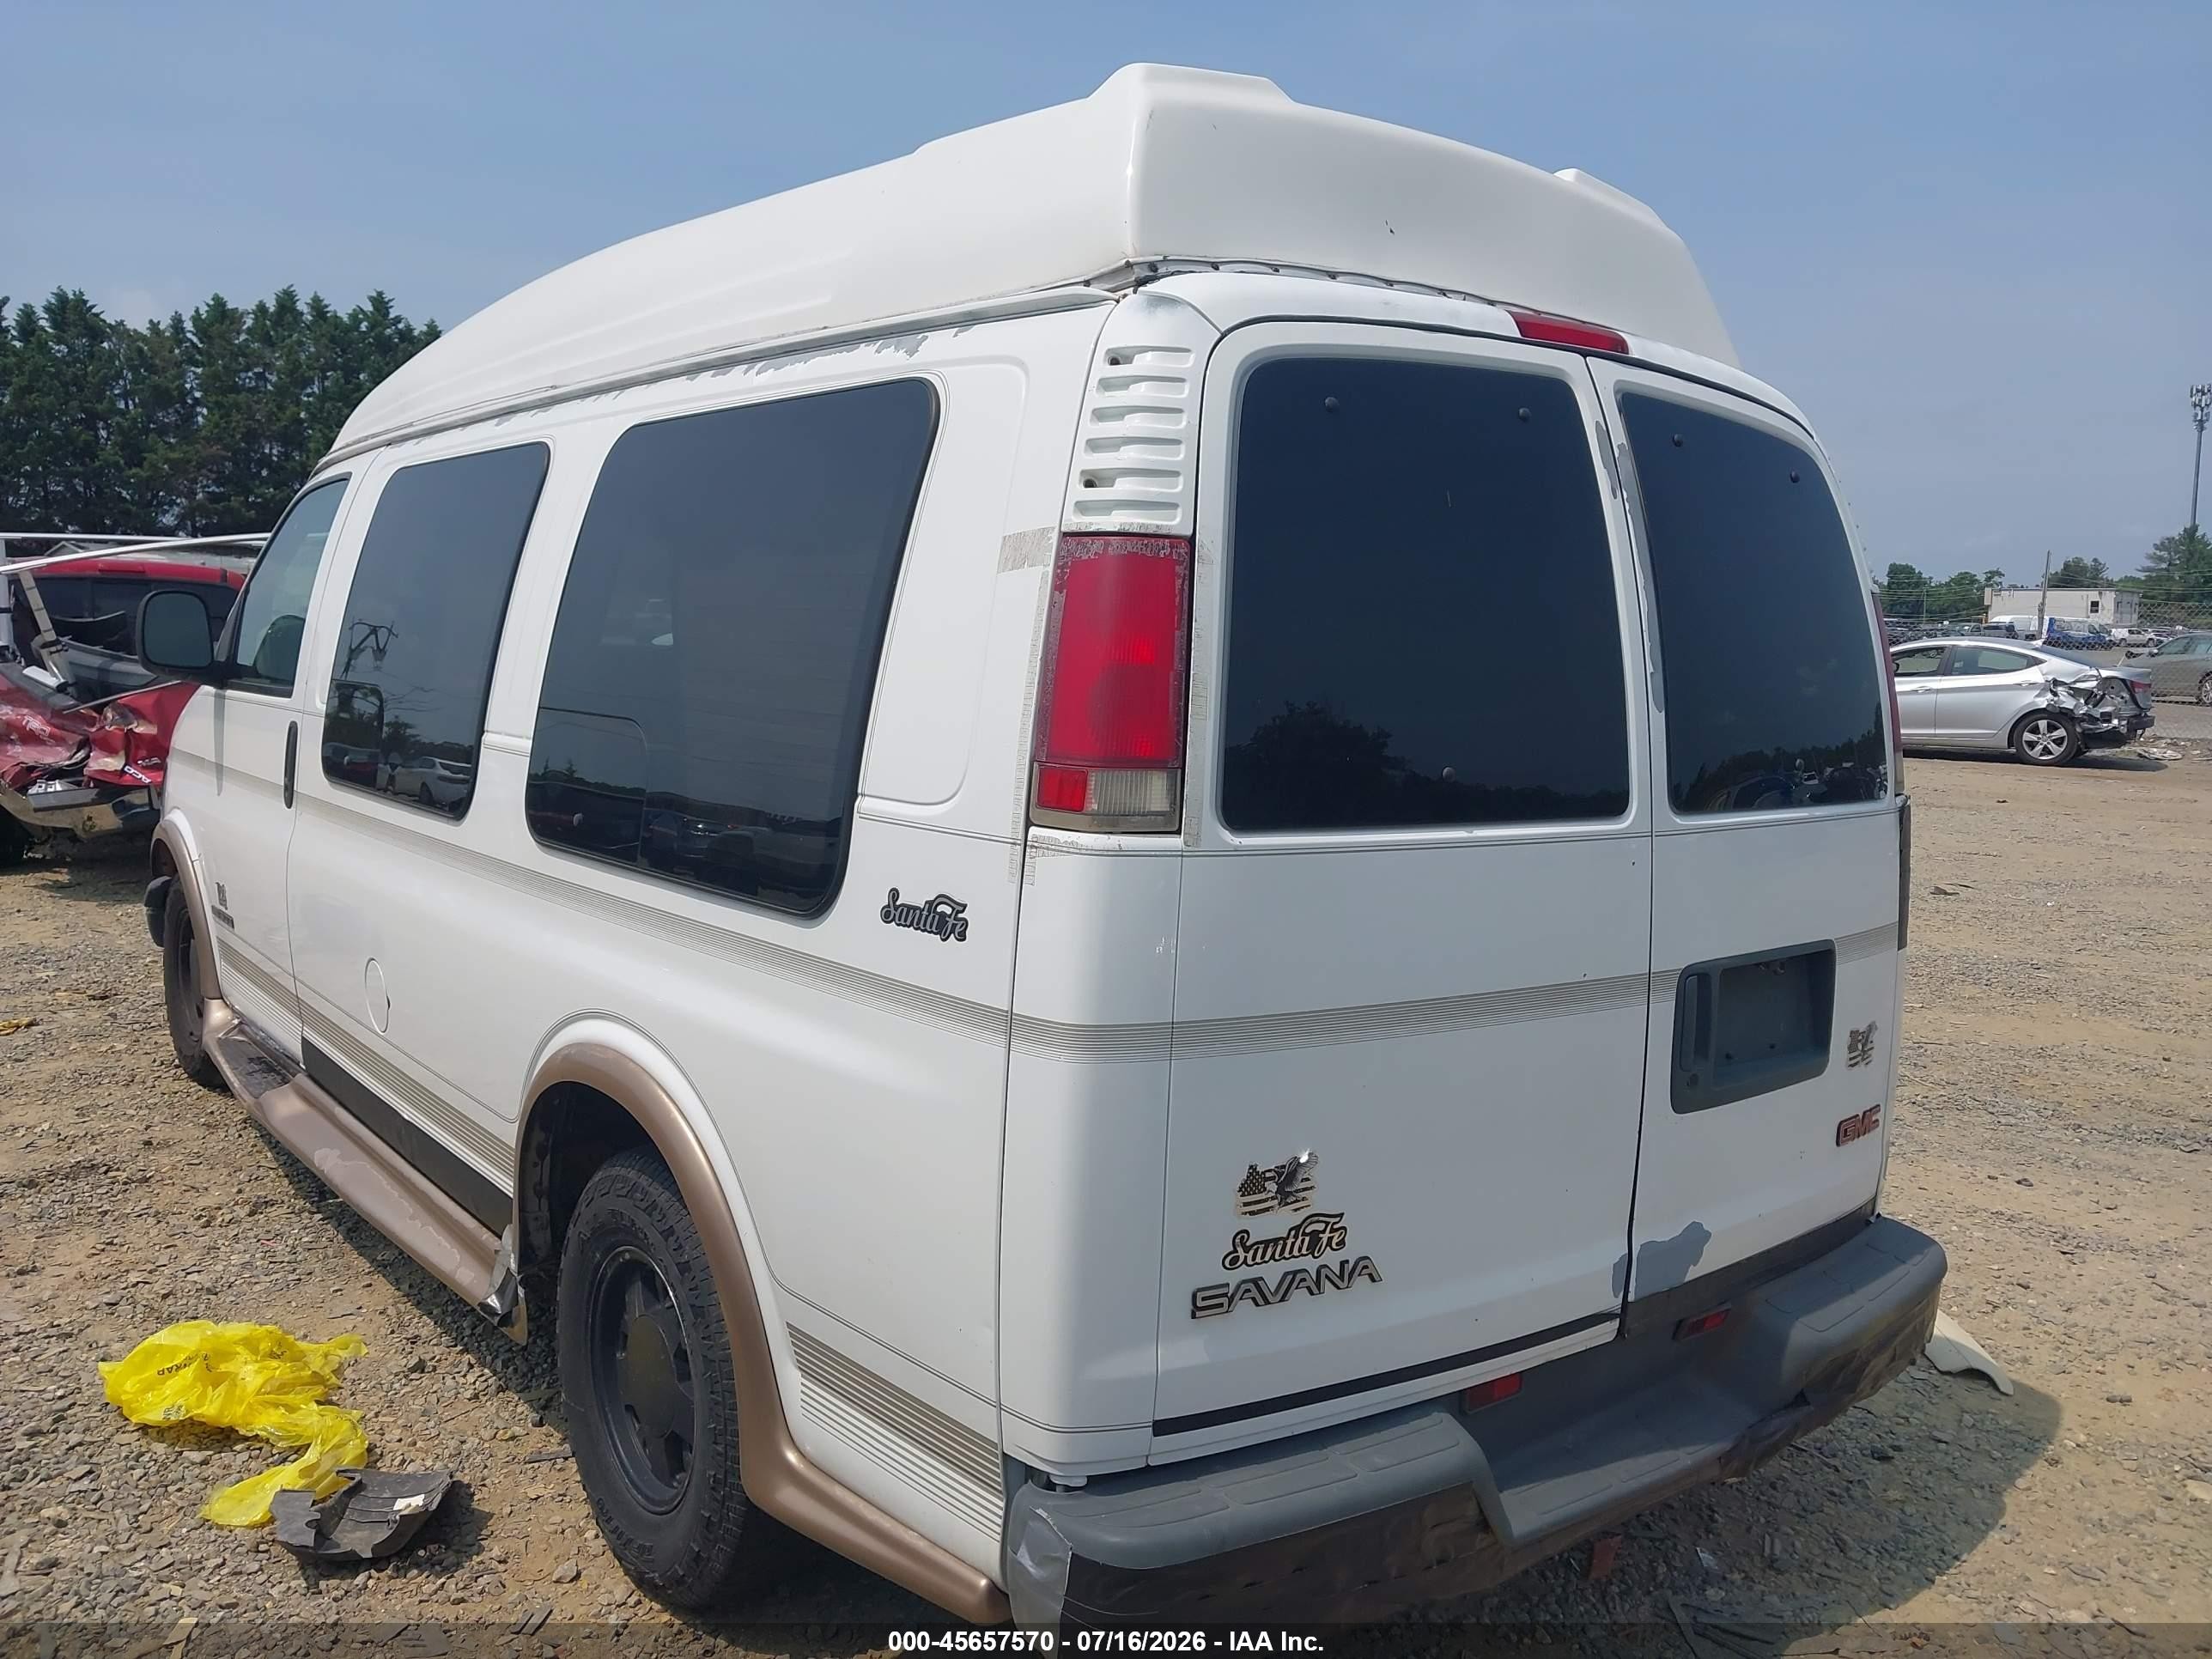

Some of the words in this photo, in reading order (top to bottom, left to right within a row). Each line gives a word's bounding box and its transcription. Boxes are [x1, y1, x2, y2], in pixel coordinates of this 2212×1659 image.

[880, 887, 940, 935] Santa
[932, 894, 969, 942] Fe
[1836, 1103, 1881, 1147] GMC
[1222, 1229, 1311, 1270] Santa
[1300, 1212, 1348, 1259] Fe
[1191, 1255, 1382, 1319] SAVANA
